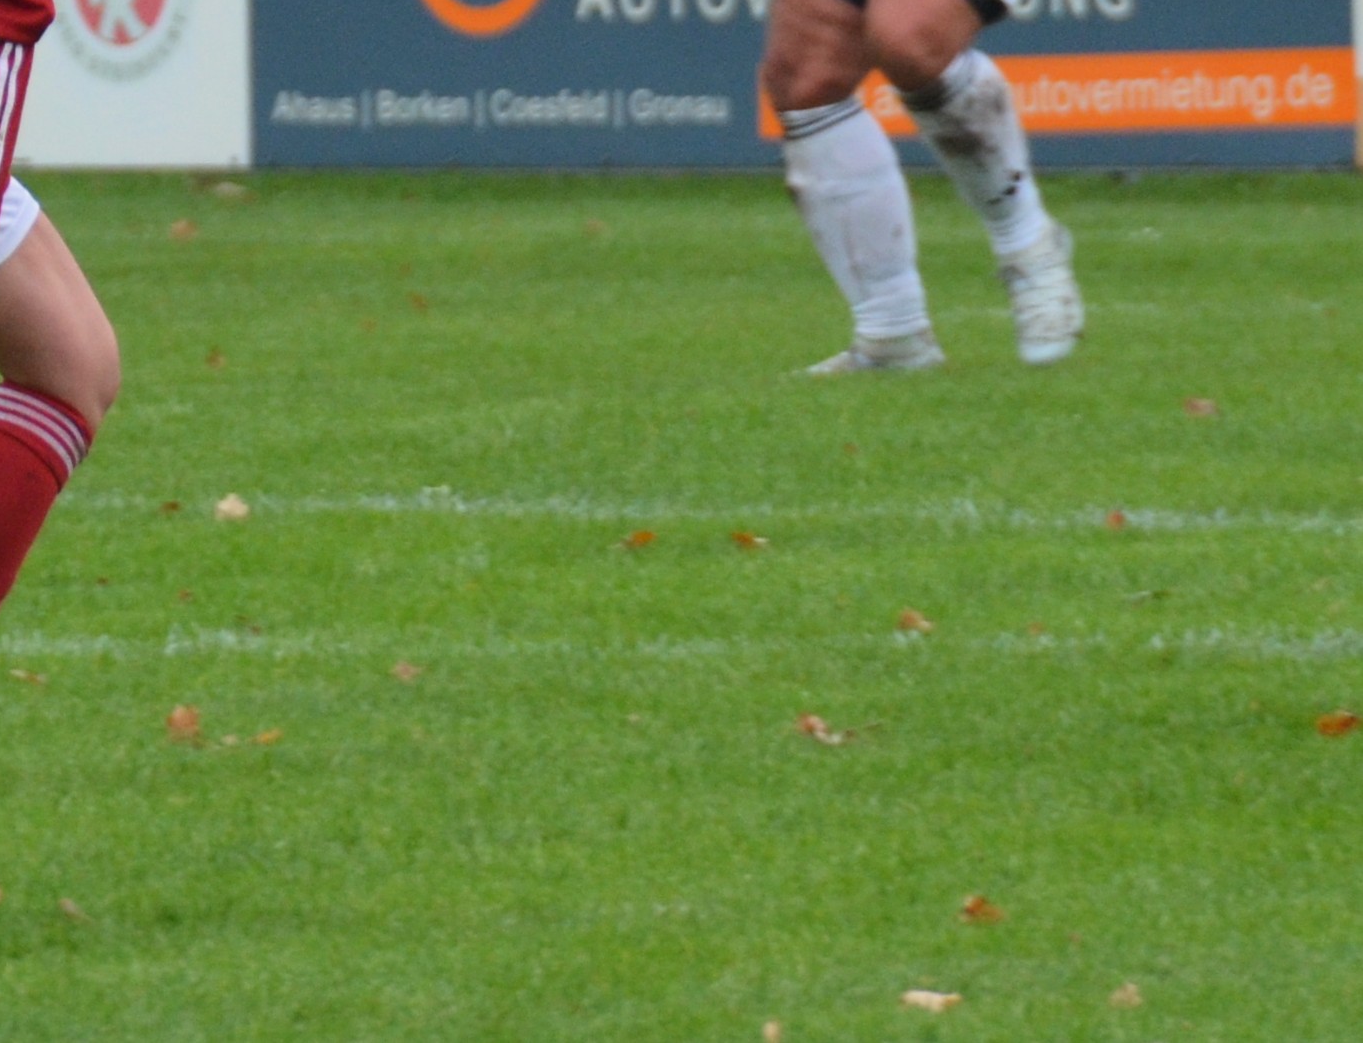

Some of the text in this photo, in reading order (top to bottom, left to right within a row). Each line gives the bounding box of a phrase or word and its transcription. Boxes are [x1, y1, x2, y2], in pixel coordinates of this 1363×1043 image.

[272, 89, 356, 125] Ahaus
[376, 88, 470, 125] Borken
[629, 87, 730, 125] Gronau
